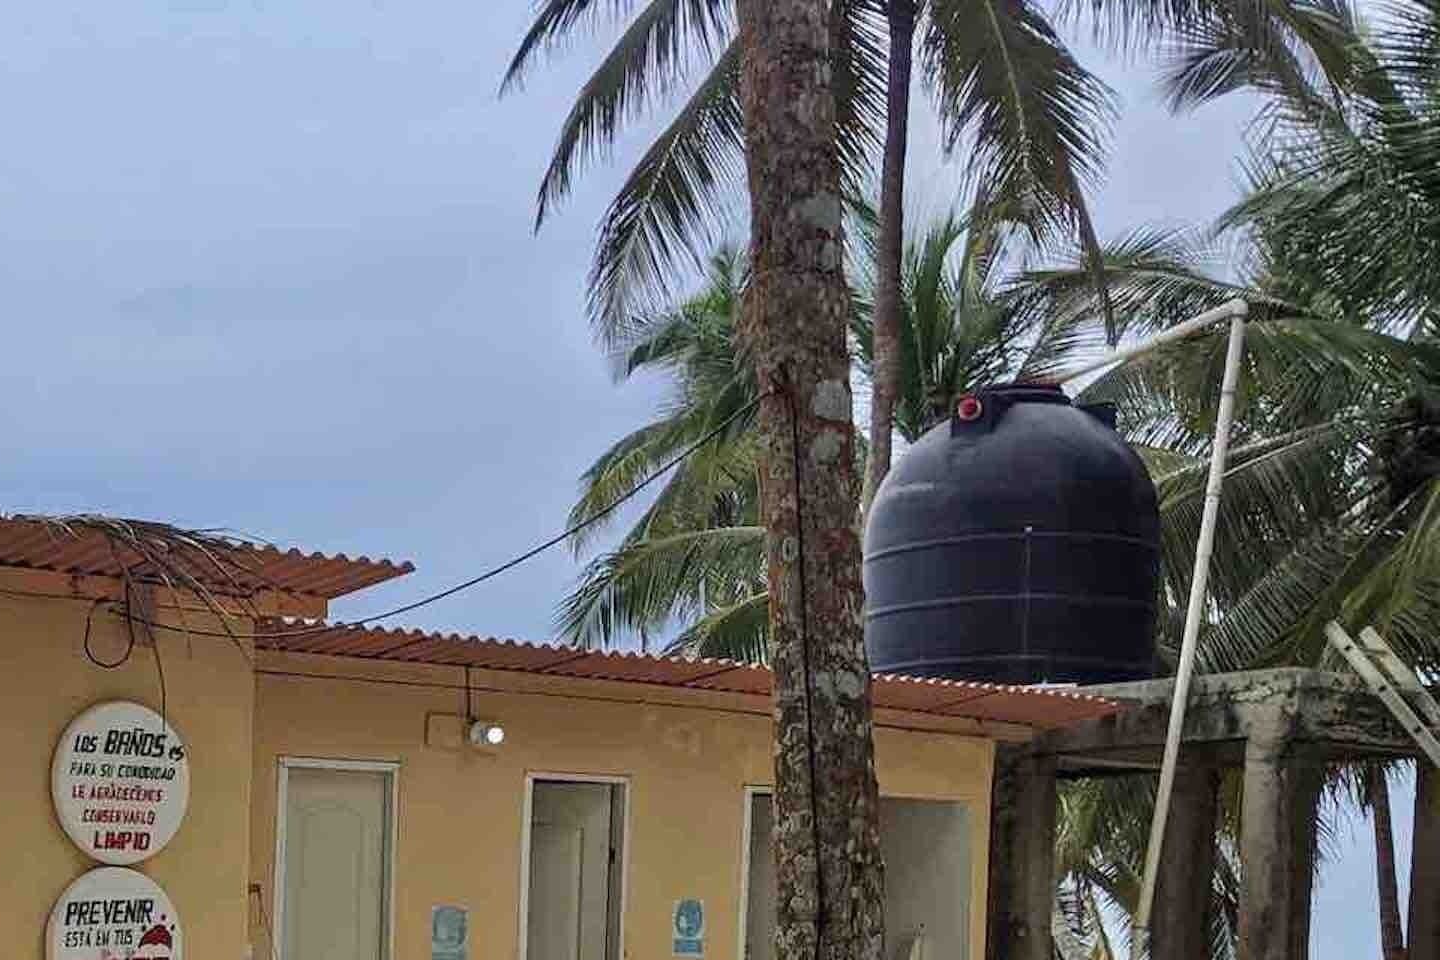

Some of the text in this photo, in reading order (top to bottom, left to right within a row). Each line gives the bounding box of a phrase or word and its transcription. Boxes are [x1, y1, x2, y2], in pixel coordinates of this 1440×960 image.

[74, 735, 98, 753] LOS
[103, 728, 168, 759] BAÑOS
[69, 761, 97, 777] PARA
[100, 763, 112, 777] SU
[71, 784, 85, 799] LE
[93, 831, 151, 851] LIMPIO
[64, 899, 154, 926] PREVENIR
[95, 931, 109, 947] EN
[113, 929, 134, 946] TUS
